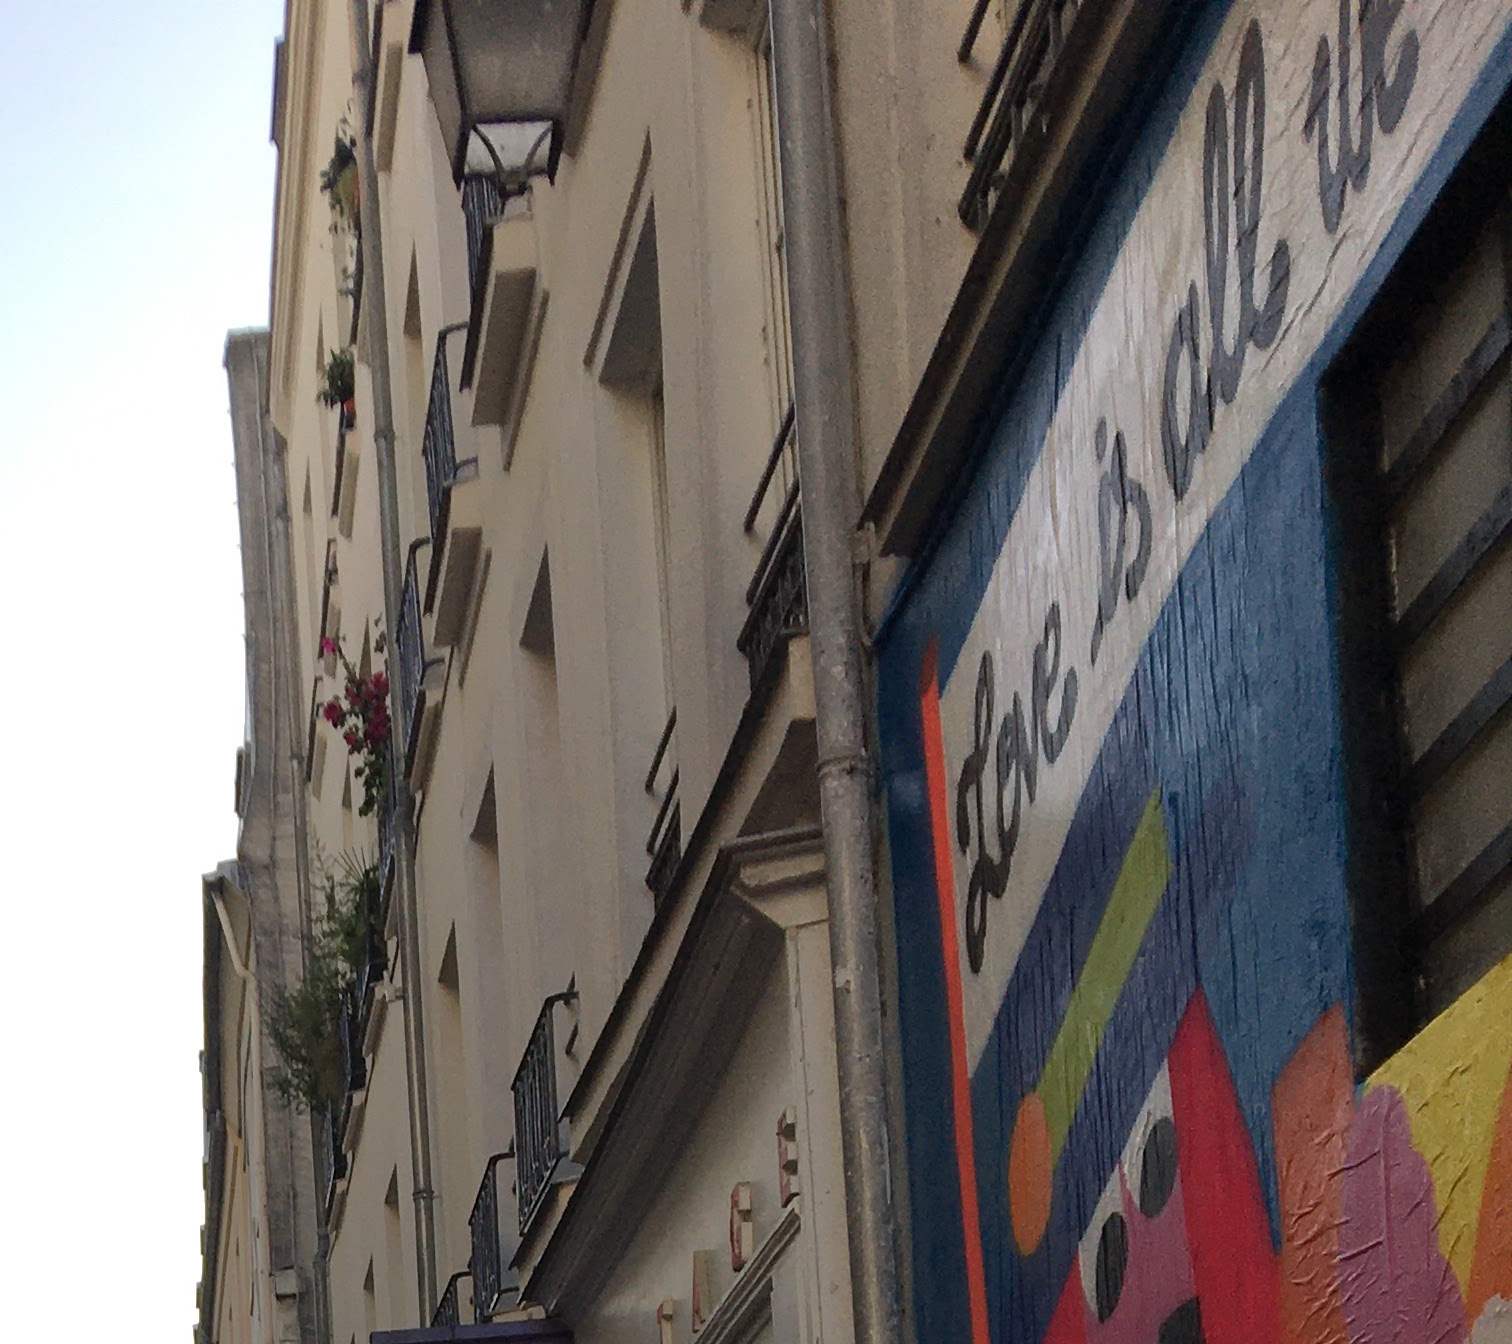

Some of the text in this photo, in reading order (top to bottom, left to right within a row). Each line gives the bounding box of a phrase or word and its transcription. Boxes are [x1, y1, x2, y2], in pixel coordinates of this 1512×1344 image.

[956, 601, 1080, 975] Love
[1090, 417, 1152, 667] is
[1160, 16, 1290, 503] all
